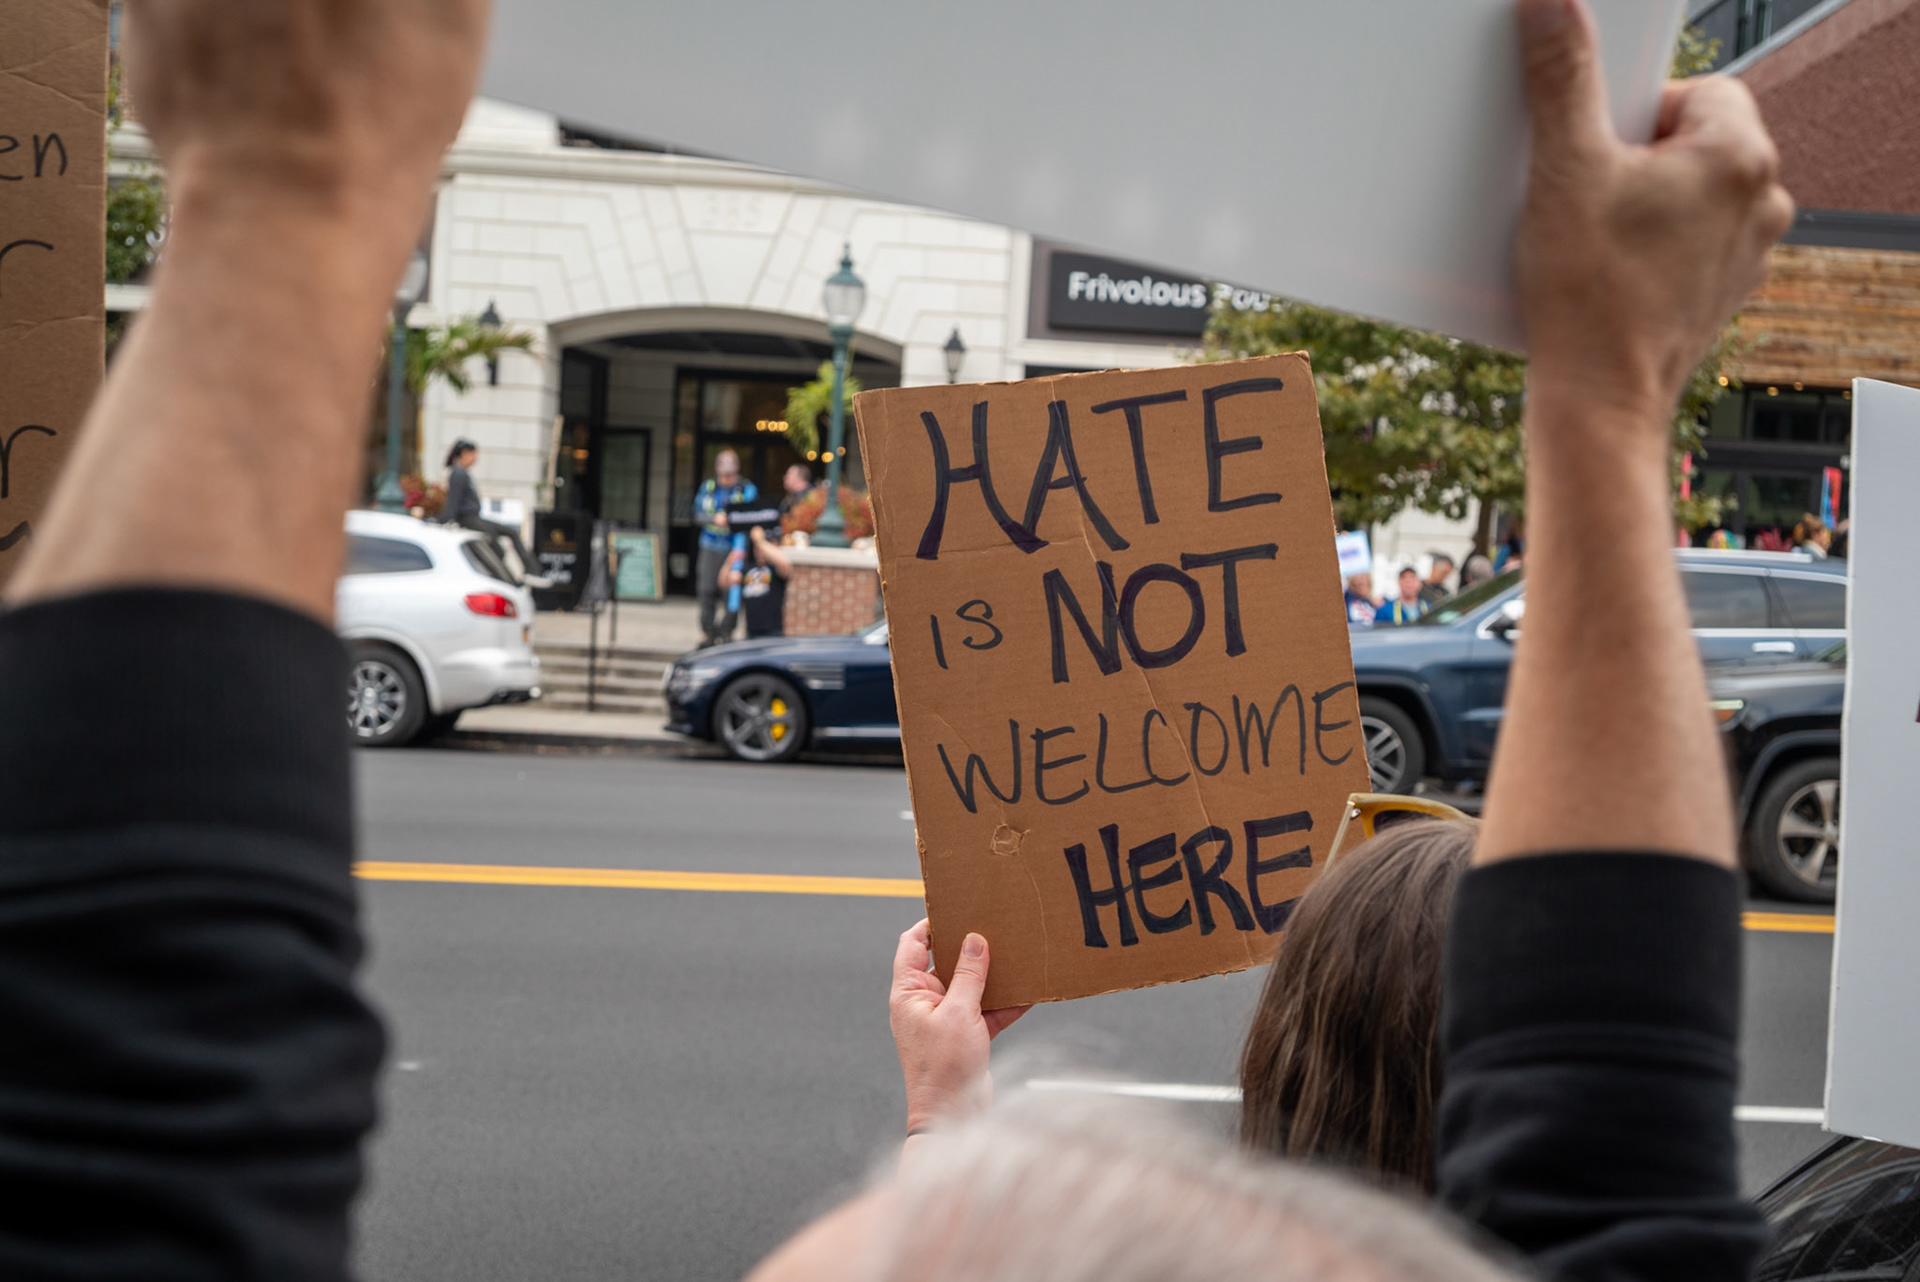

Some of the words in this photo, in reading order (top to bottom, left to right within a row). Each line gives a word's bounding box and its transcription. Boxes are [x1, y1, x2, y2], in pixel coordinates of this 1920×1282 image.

[1067, 270, 1207, 308] Frivolous
[915, 377, 1284, 560] HATE
[1044, 543, 1279, 683] NOT
[937, 681, 1356, 813] WELCOME
[1063, 810, 1313, 948] HERE
